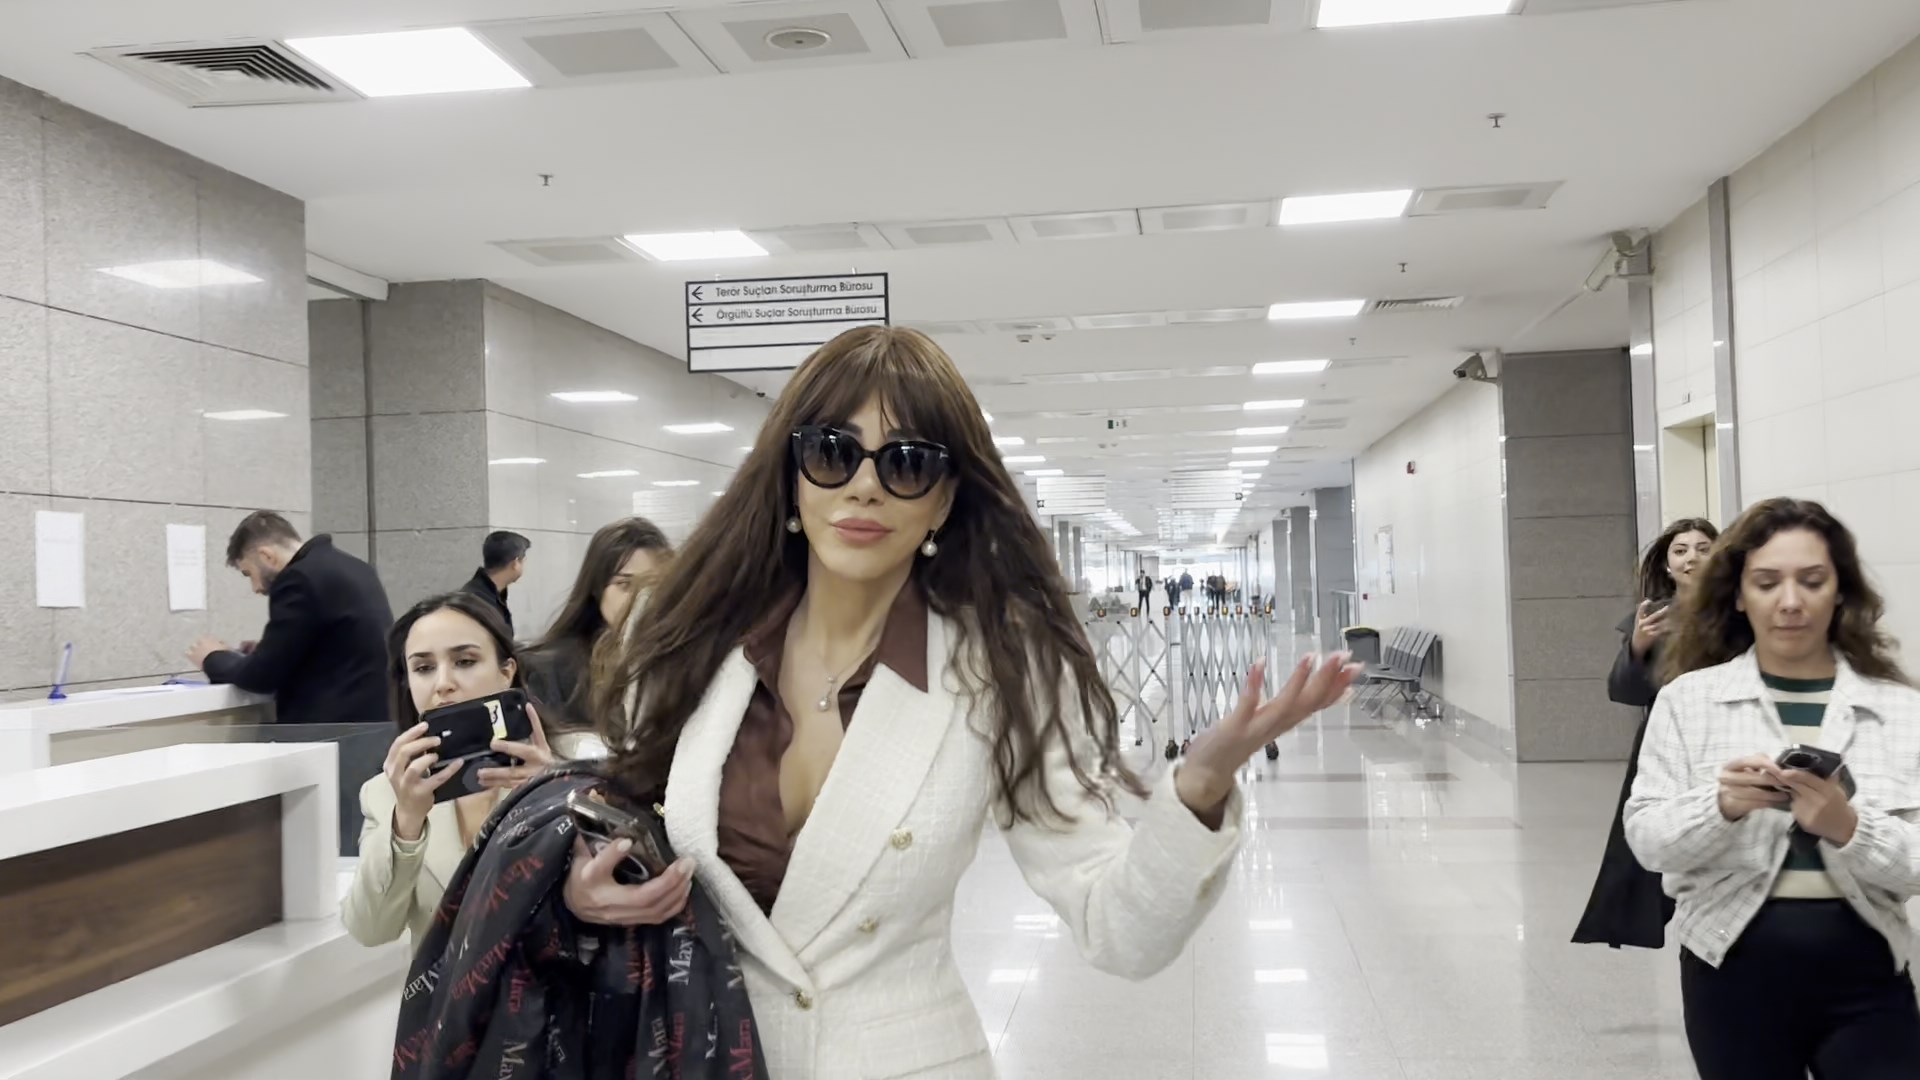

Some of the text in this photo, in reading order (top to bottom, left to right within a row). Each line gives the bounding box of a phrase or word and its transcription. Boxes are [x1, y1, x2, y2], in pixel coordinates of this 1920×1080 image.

[716, 286, 740, 297] Terör
[780, 283, 837, 296] Soruşturma
[840, 280, 873, 291] Bürosu
[755, 307, 785, 319] Suçlar
[787, 306, 842, 318] Soruşturma
[845, 304, 877, 315] Bürosu
